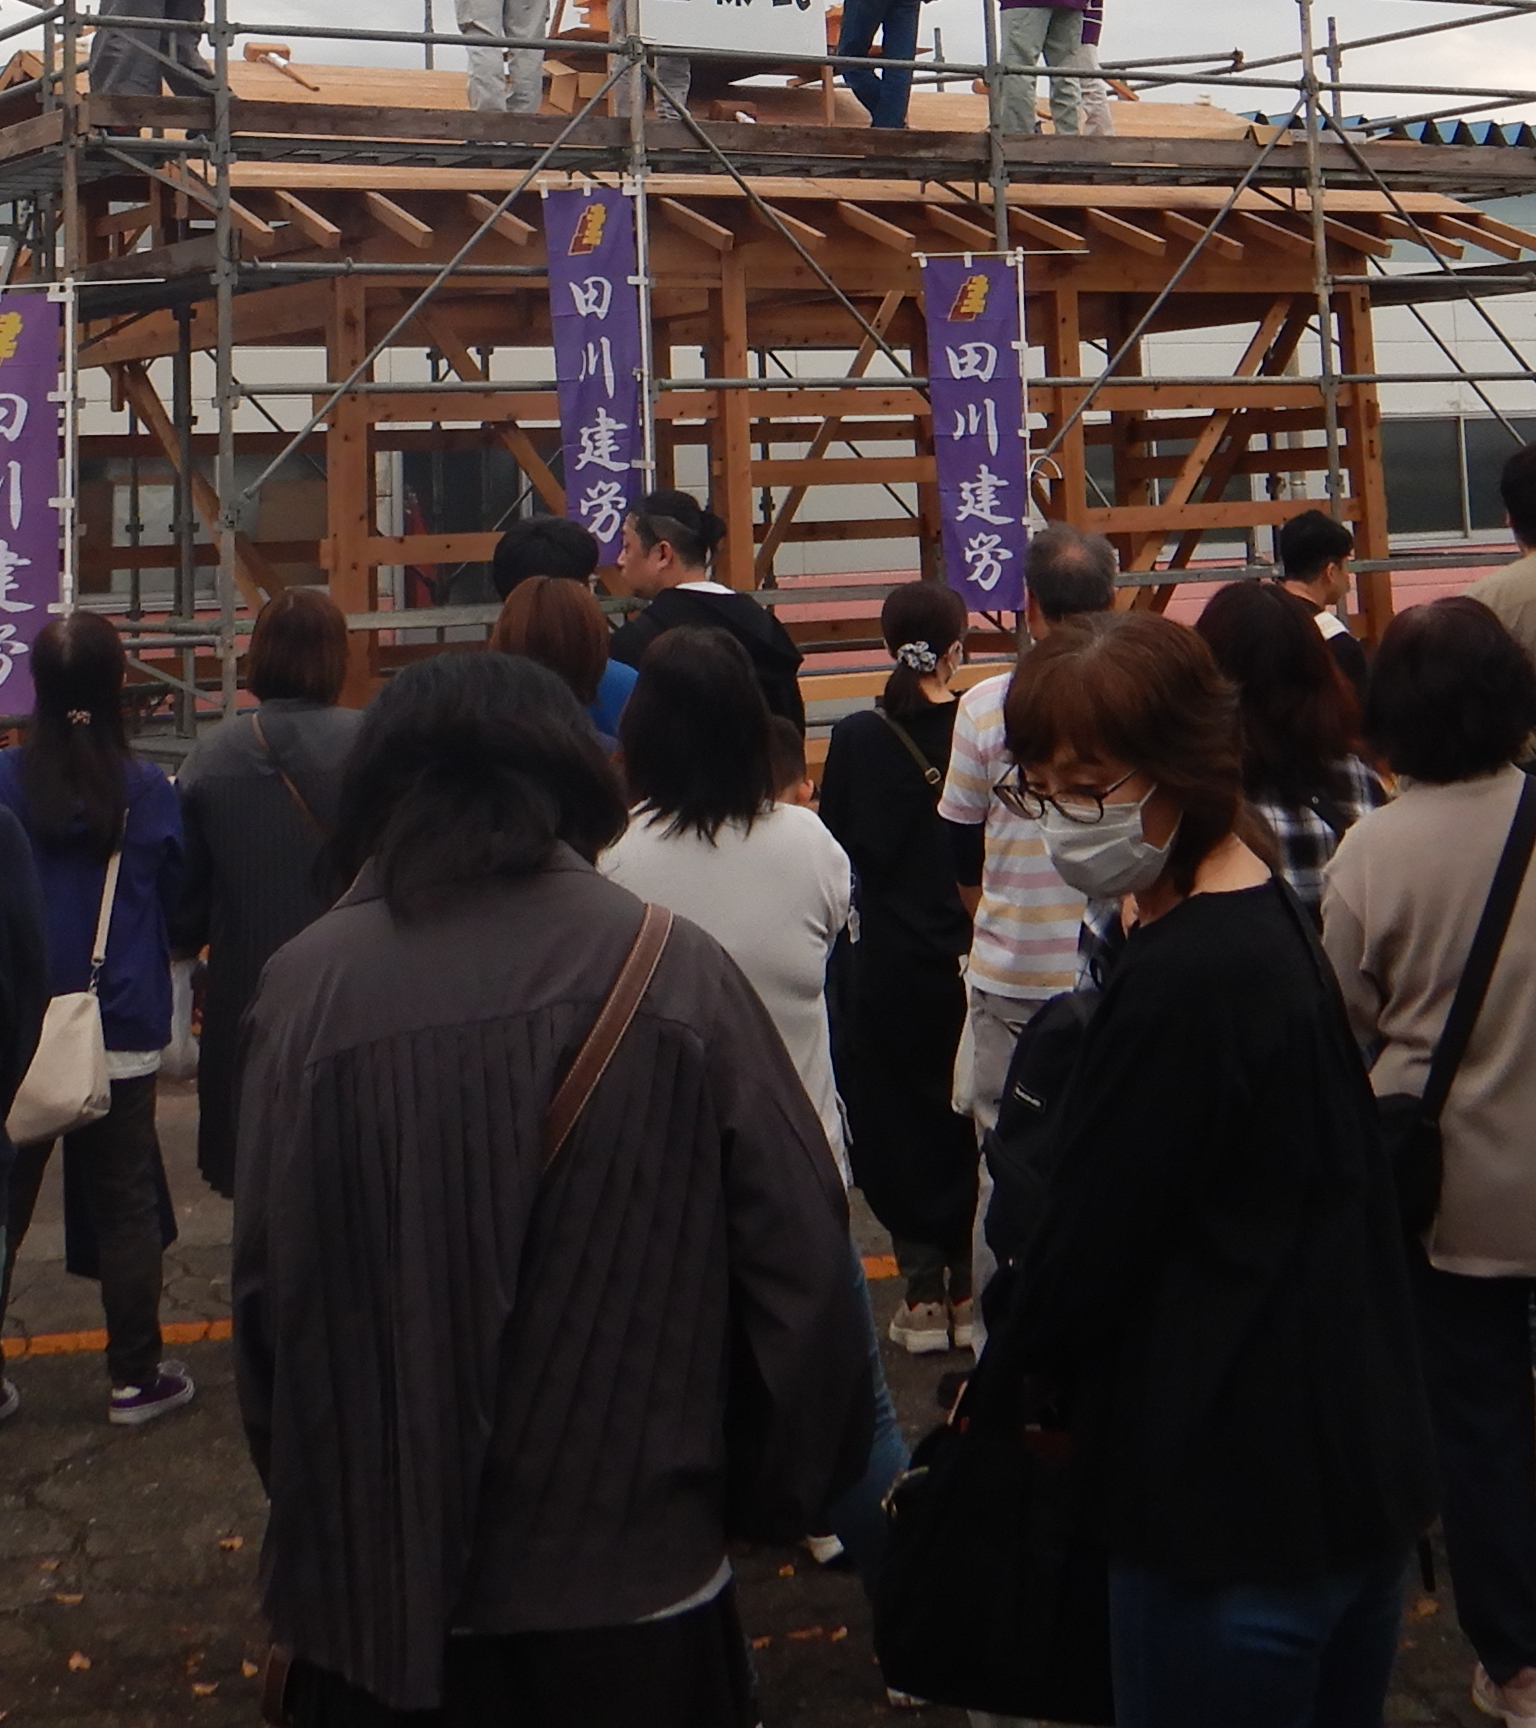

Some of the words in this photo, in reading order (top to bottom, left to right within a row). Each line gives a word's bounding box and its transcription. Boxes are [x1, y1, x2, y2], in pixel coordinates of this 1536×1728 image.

[568, 275, 631, 544] 田川建労
[945, 341, 1015, 592] 田川建労
